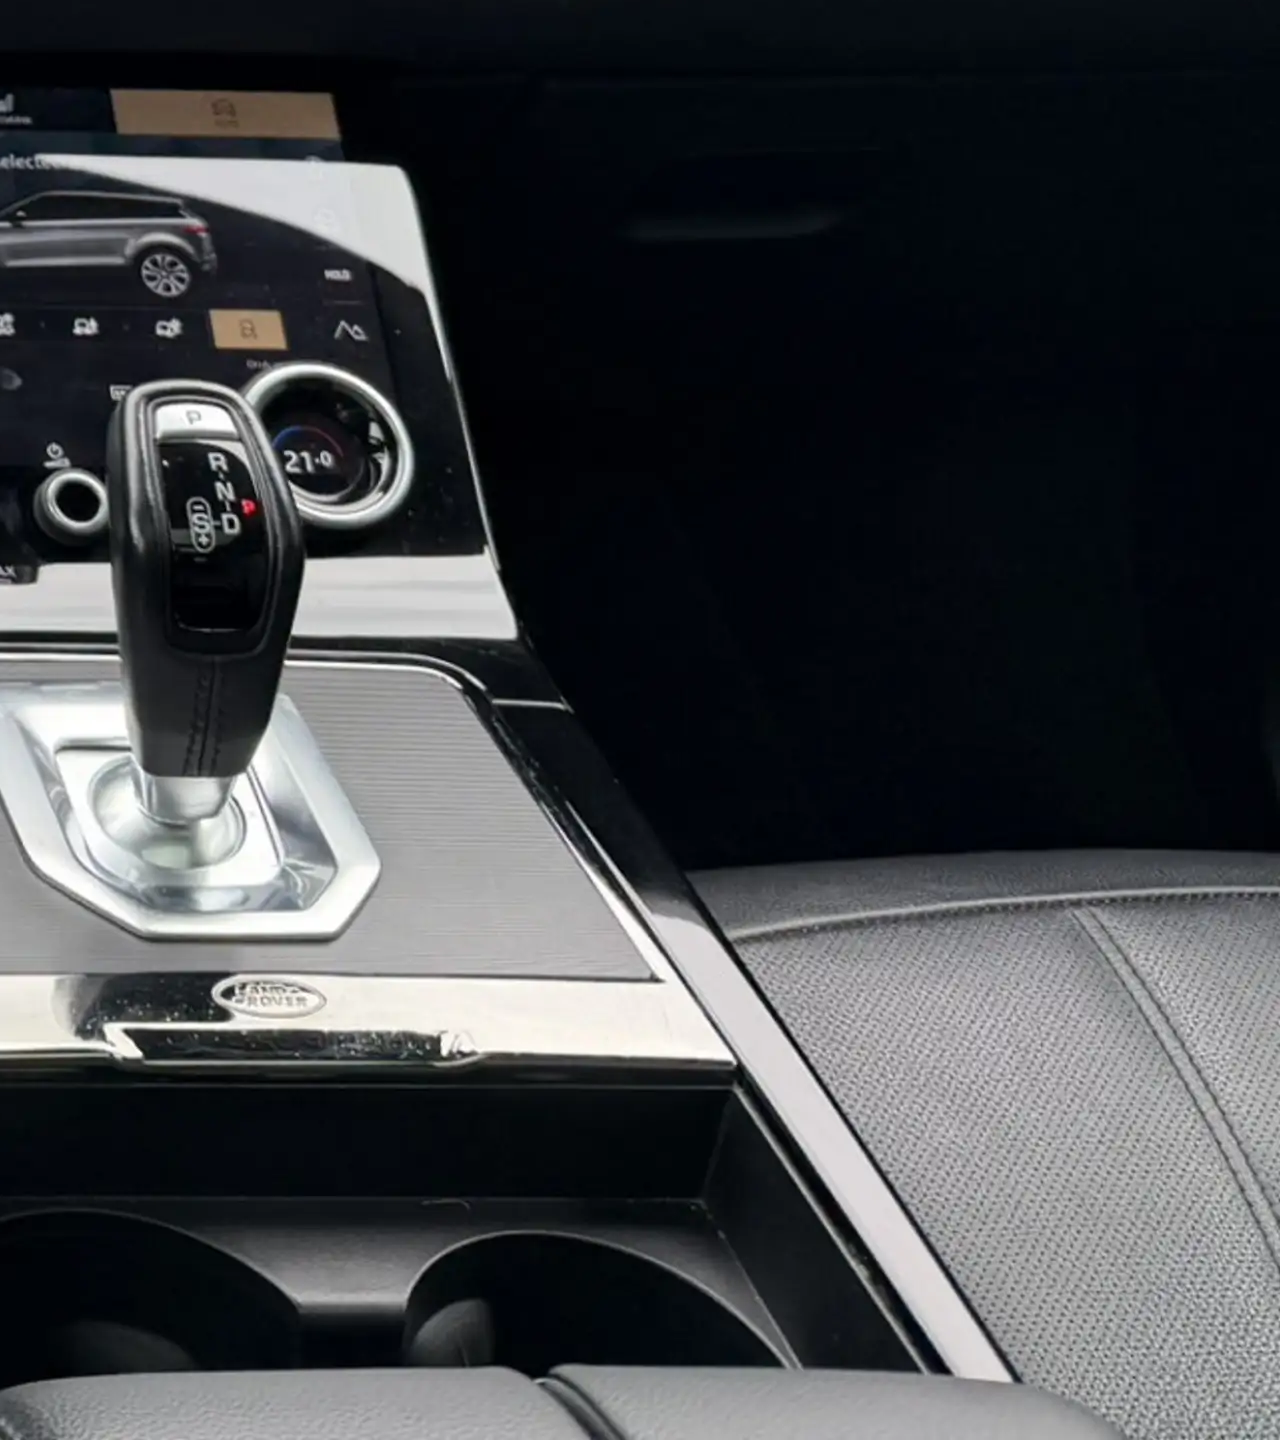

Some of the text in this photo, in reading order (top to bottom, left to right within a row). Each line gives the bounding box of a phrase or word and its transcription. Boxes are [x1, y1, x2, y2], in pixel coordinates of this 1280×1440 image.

[185, 410, 202, 425] P
[208, 451, 228, 472] R
[215, 481, 235, 502] N
[192, 513, 240, 535] S D
[247, 995, 309, 1008] ROVER
